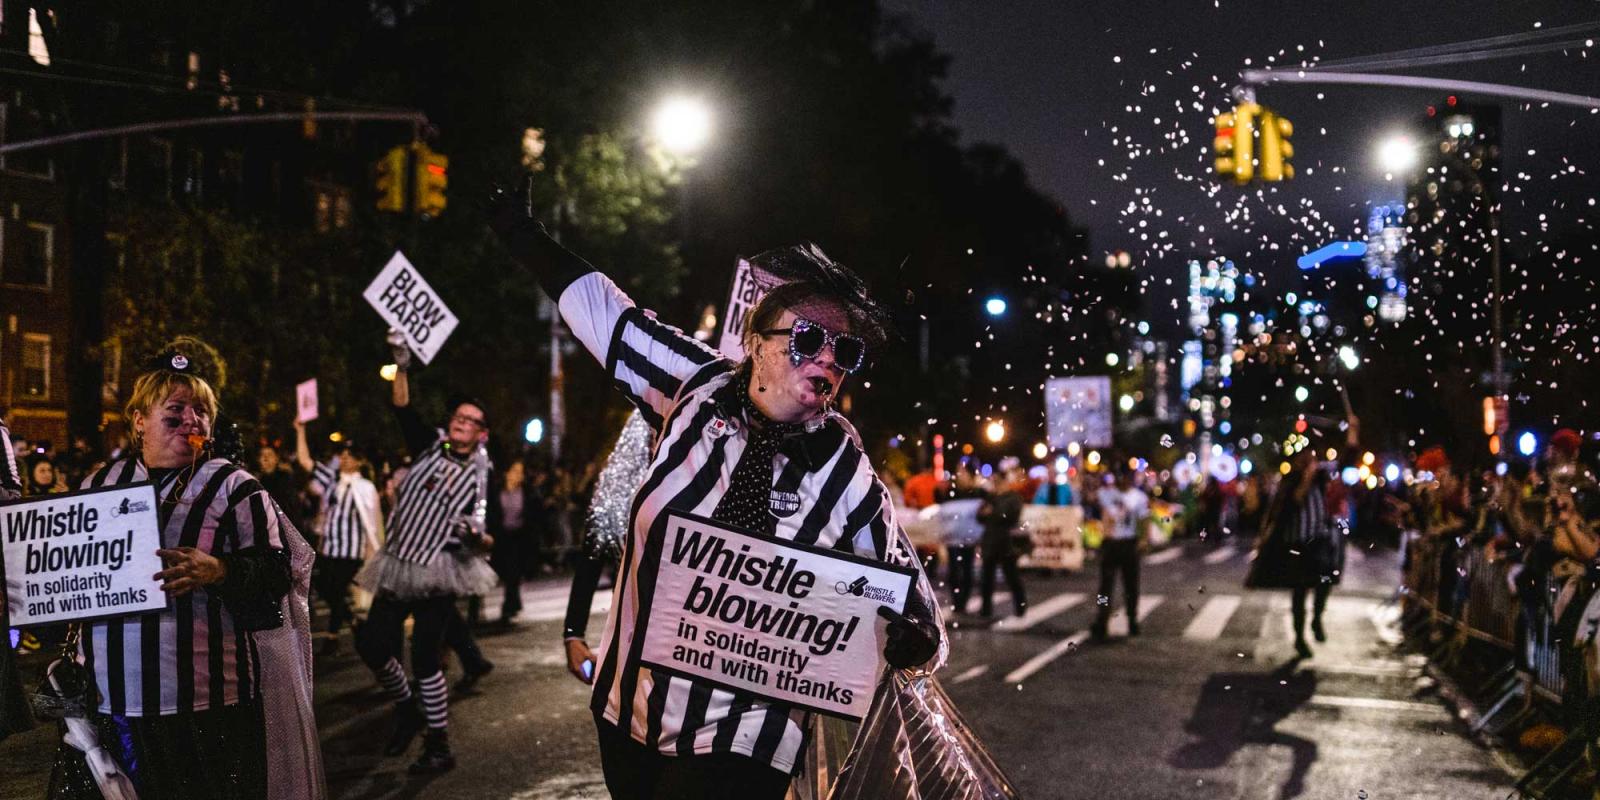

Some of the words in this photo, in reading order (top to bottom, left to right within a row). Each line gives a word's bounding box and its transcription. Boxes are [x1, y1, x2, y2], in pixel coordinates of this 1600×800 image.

[379, 284, 431, 344] HARD
[392, 267, 446, 329] BLOW
[768, 499, 799, 511] TRUMP
[770, 490, 799, 503] IMPEACH
[6, 502, 98, 544] Whistle
[25, 530, 133, 575] blowing!
[670, 526, 816, 599] Whistle
[26, 580, 40, 597] in
[44, 572, 112, 595] solidarity
[28, 598, 55, 617] and
[58, 593, 92, 612] with
[95, 588, 147, 608] thanks
[864, 585, 895, 597] WHISTLE
[864, 591, 896, 605] BLOWERS
[683, 575, 860, 656] blowing!
[677, 618, 697, 641] in
[704, 629, 809, 674] solidarity
[672, 644, 715, 670] and
[721, 656, 768, 685] with
[776, 671, 853, 705] thanks
